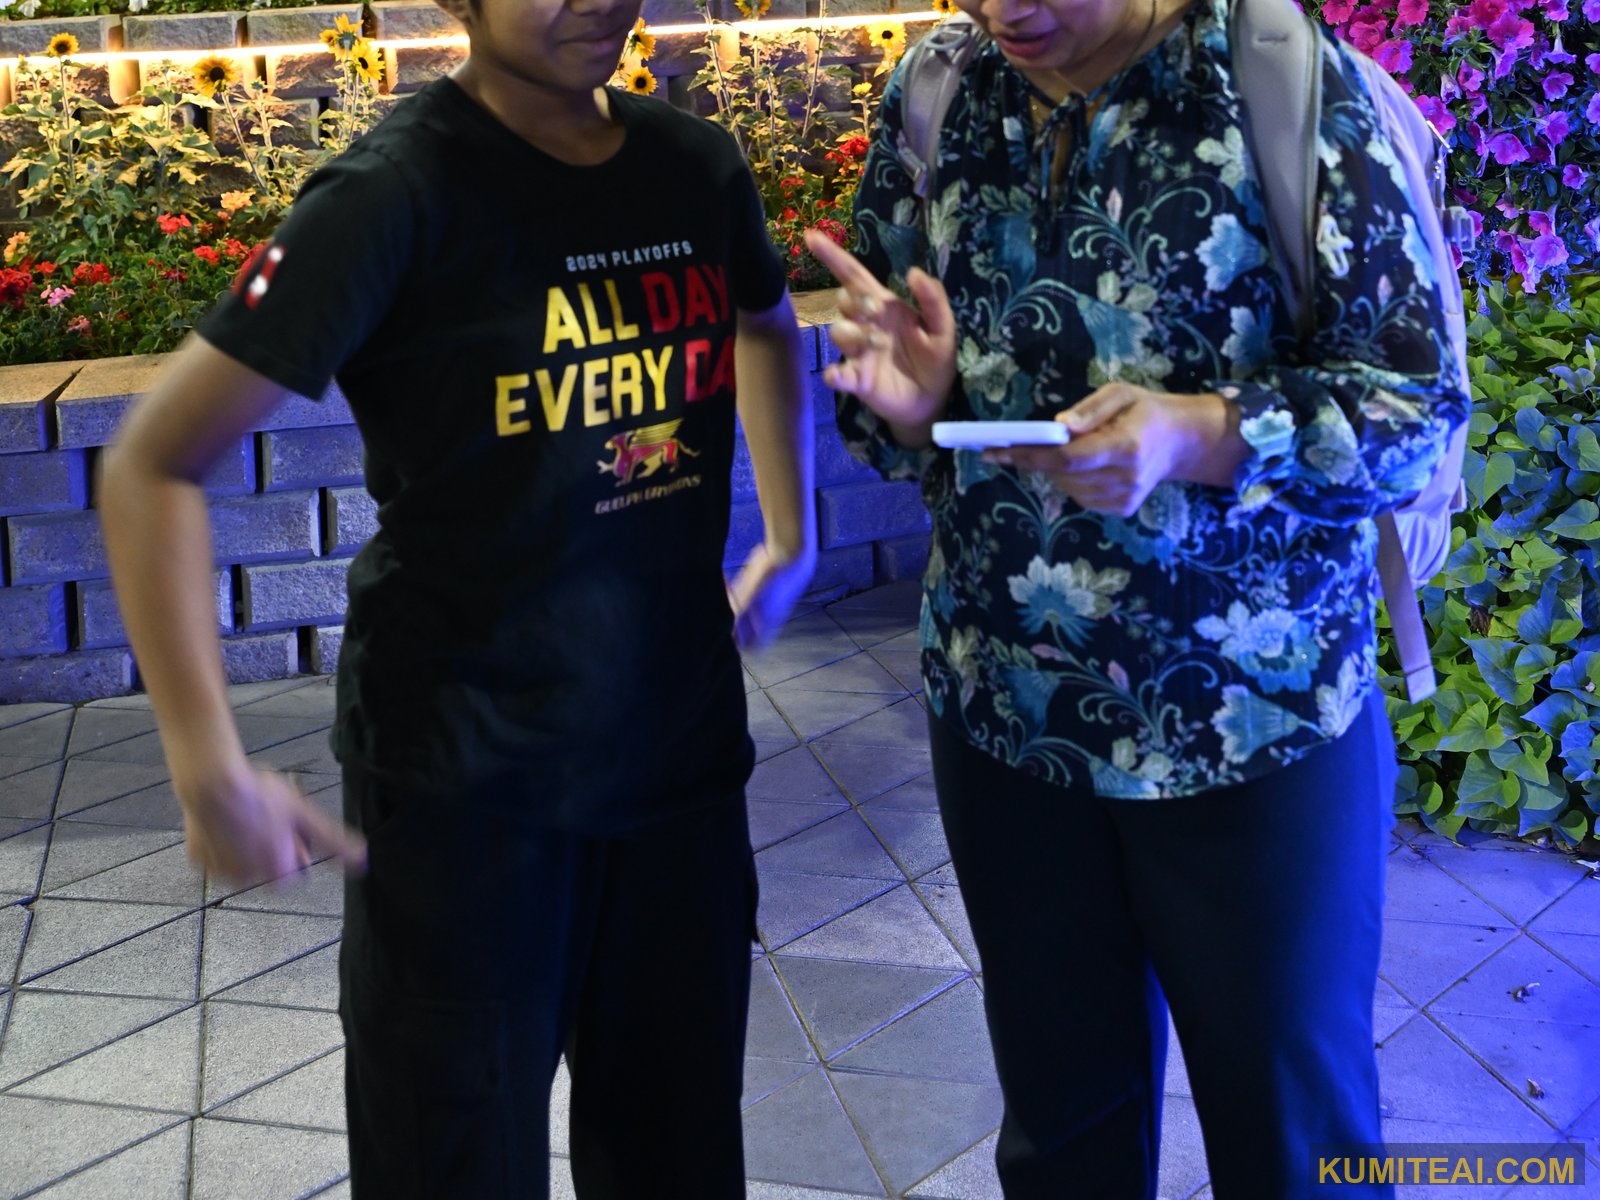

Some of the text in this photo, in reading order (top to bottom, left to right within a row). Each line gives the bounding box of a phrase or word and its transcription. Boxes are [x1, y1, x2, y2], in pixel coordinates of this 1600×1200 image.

[565, 240, 693, 272] 2024 PLAYOFFS
[543, 262, 730, 354] ALL DAY
[495, 335, 736, 437] EVERY DA
